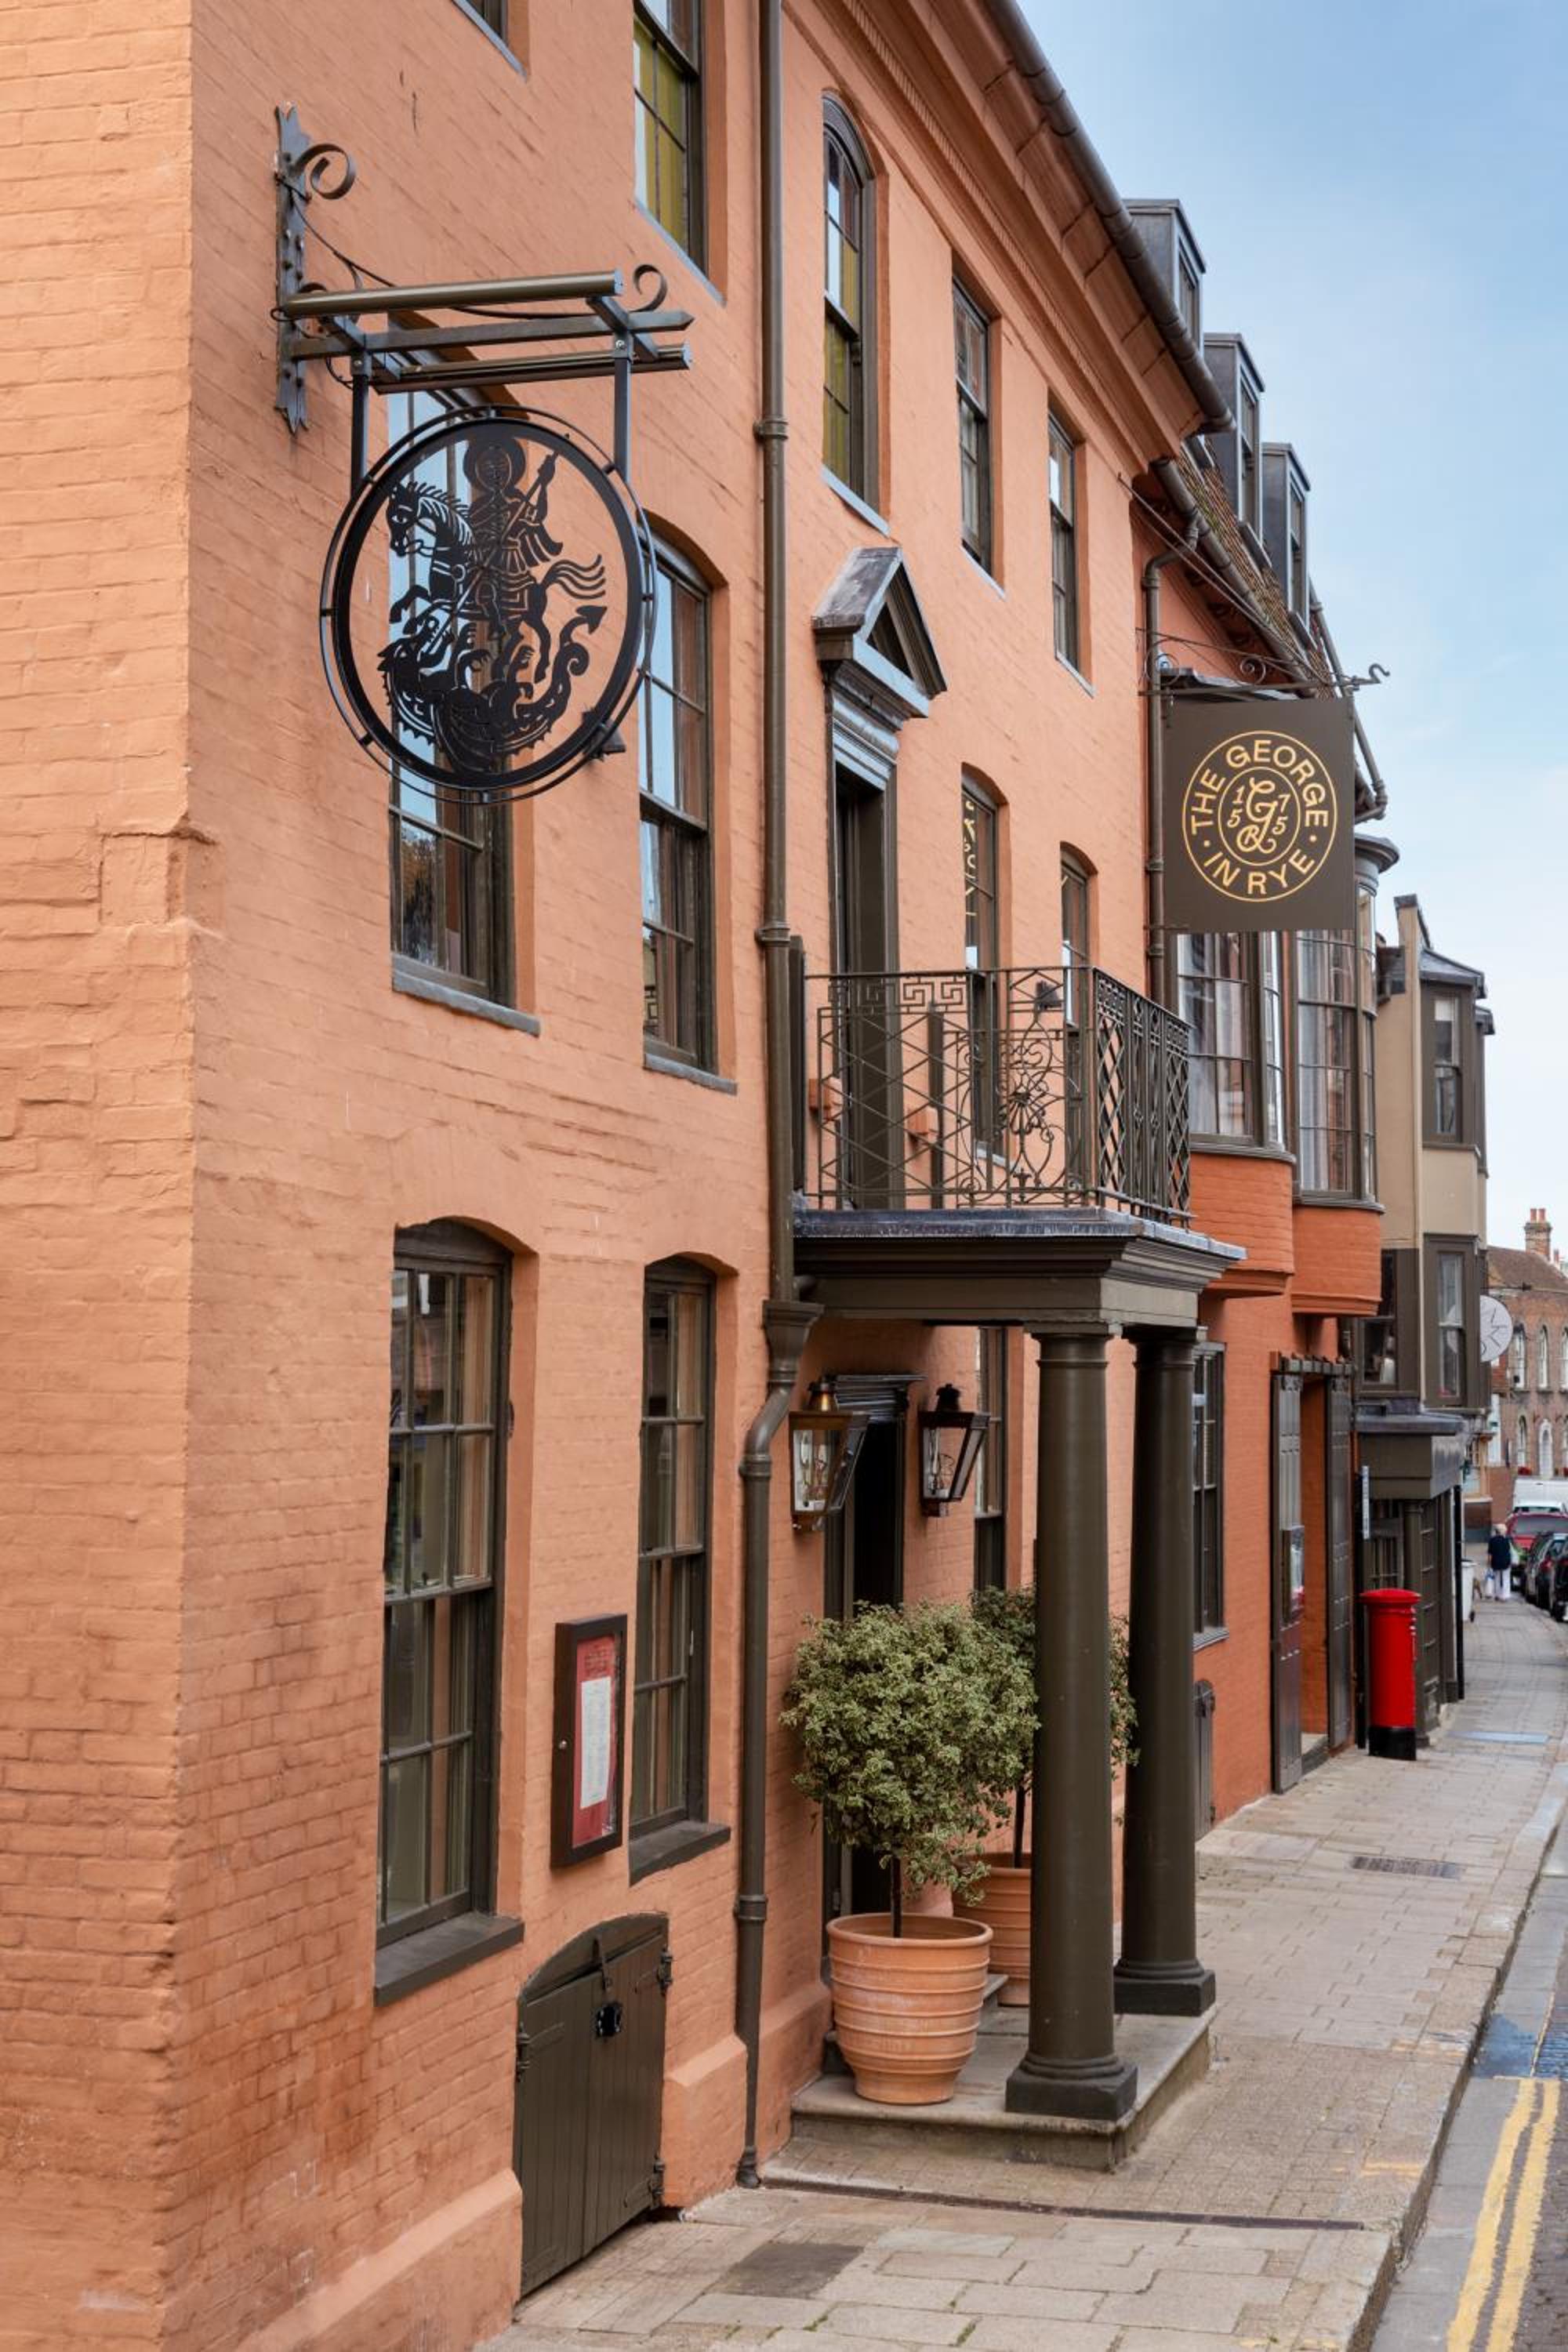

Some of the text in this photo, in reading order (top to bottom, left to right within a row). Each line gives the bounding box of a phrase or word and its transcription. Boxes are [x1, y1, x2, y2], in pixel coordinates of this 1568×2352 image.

[1191, 739, 1328, 836] THE GEORGE
[1203, 849, 1315, 895] IN RYE
